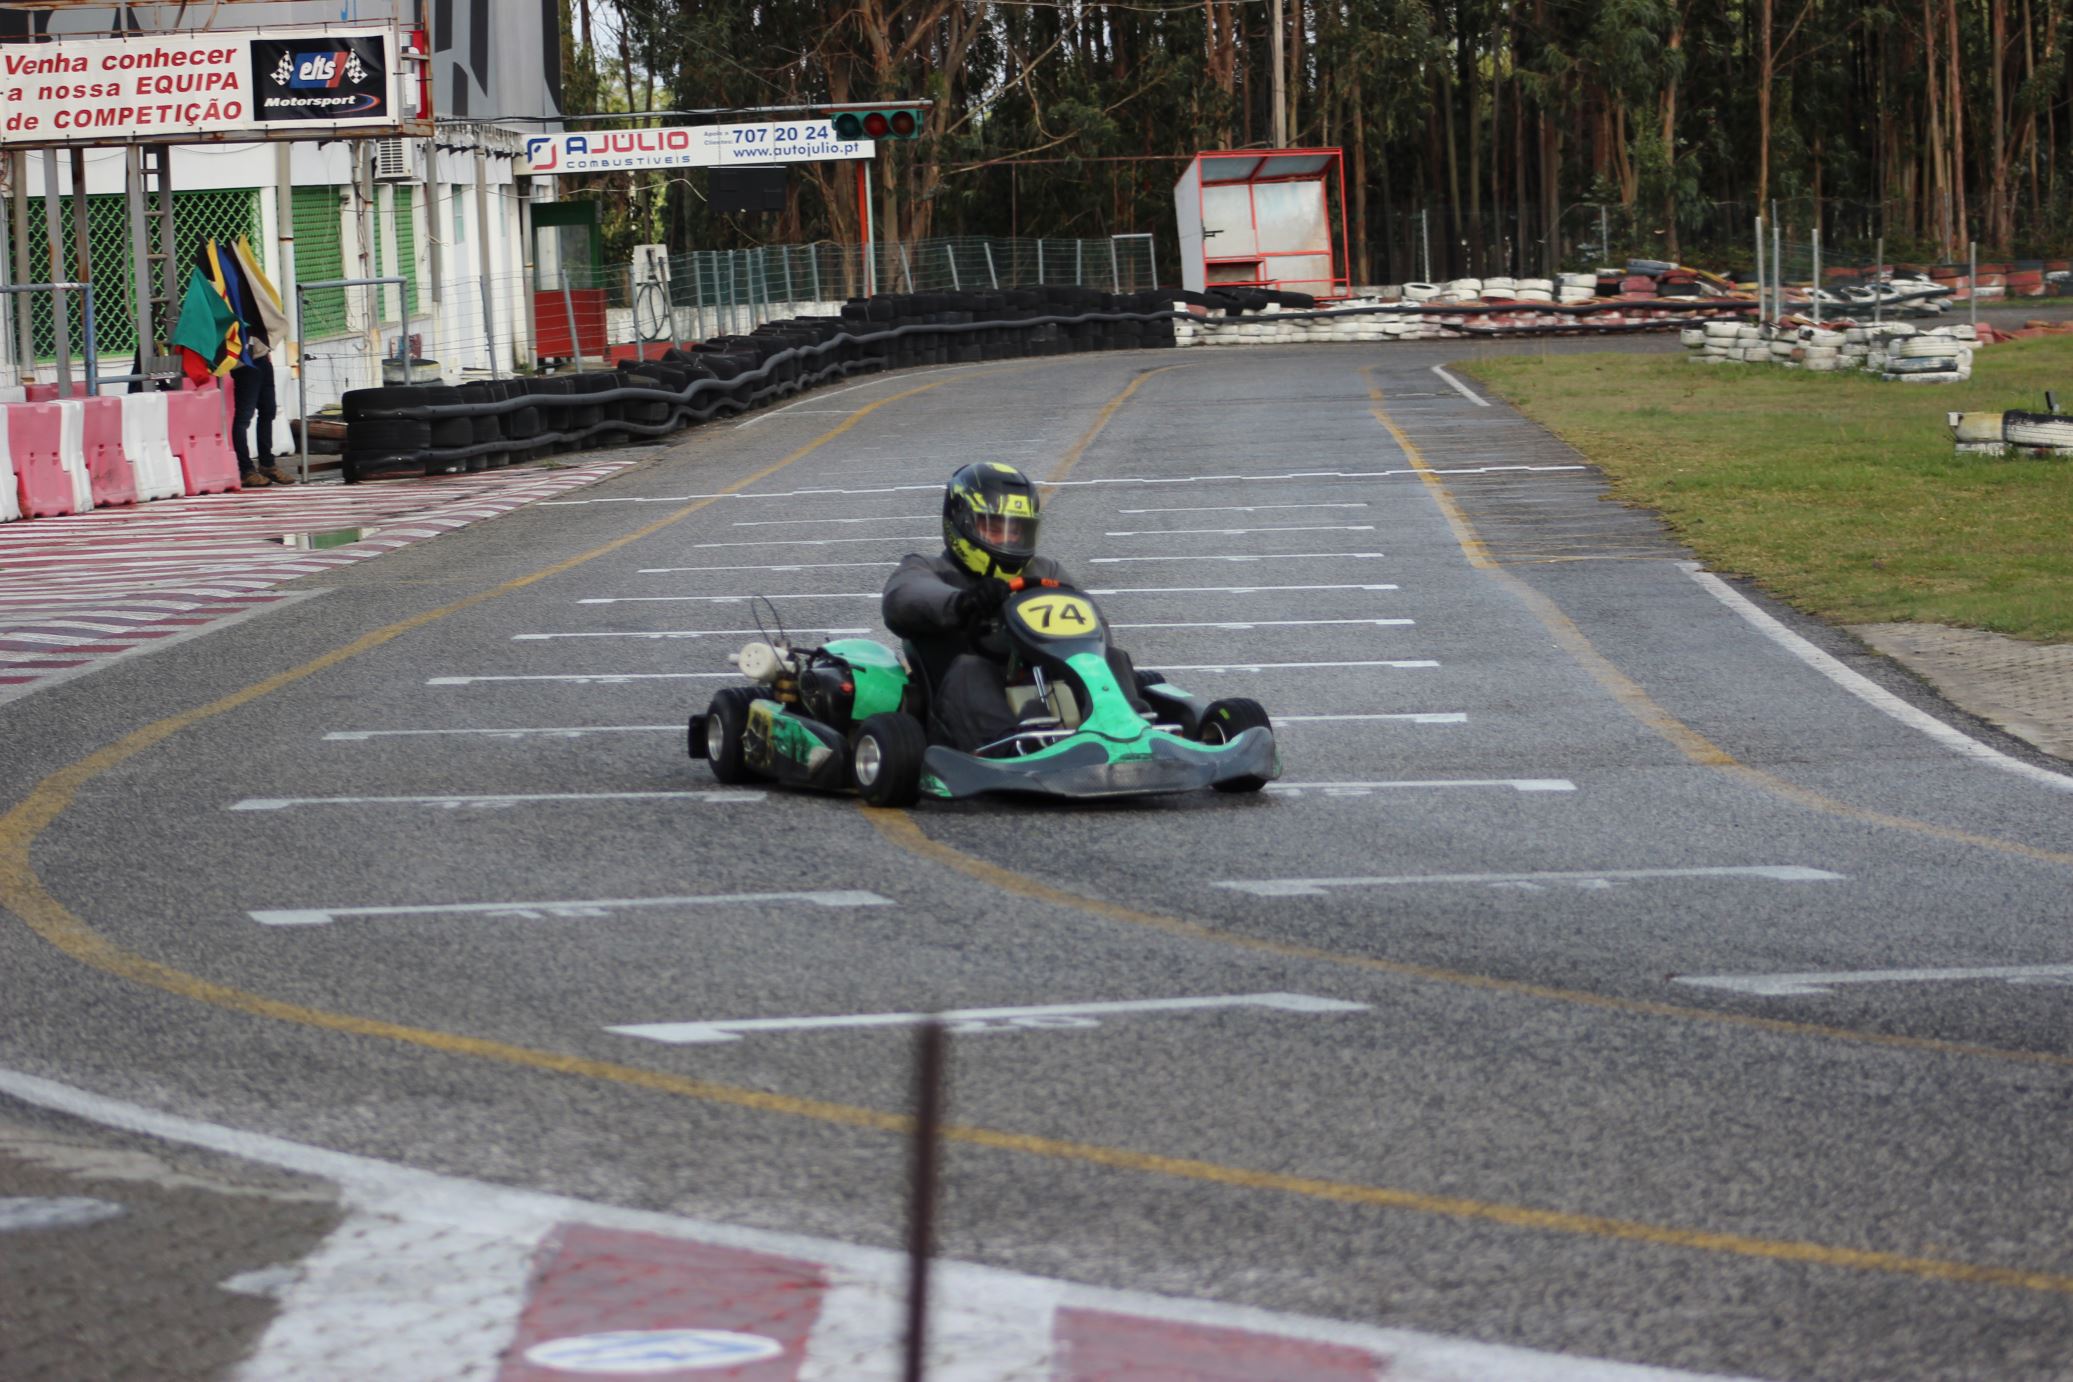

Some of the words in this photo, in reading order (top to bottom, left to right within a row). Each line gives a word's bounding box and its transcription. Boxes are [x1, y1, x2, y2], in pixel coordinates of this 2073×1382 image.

[5, 53, 88, 75] Venha
[101, 48, 238, 71] conhecer
[8, 87, 23, 101] a
[38, 82, 121, 100] nossa
[136, 72, 239, 95] EQUIPA
[264, 95, 356, 107] Motorsport
[6, 112, 39, 131] de
[54, 99, 242, 129] COMPETIÇÃO
[732, 129, 768, 144] 707
[775, 127, 798, 141] 20
[805, 126, 829, 140] 24
[733, 142, 859, 157] www.autojulio.pt
[566, 155, 690, 169] COMBUSTÍVEIS
[1028, 604, 1086, 628] 74
